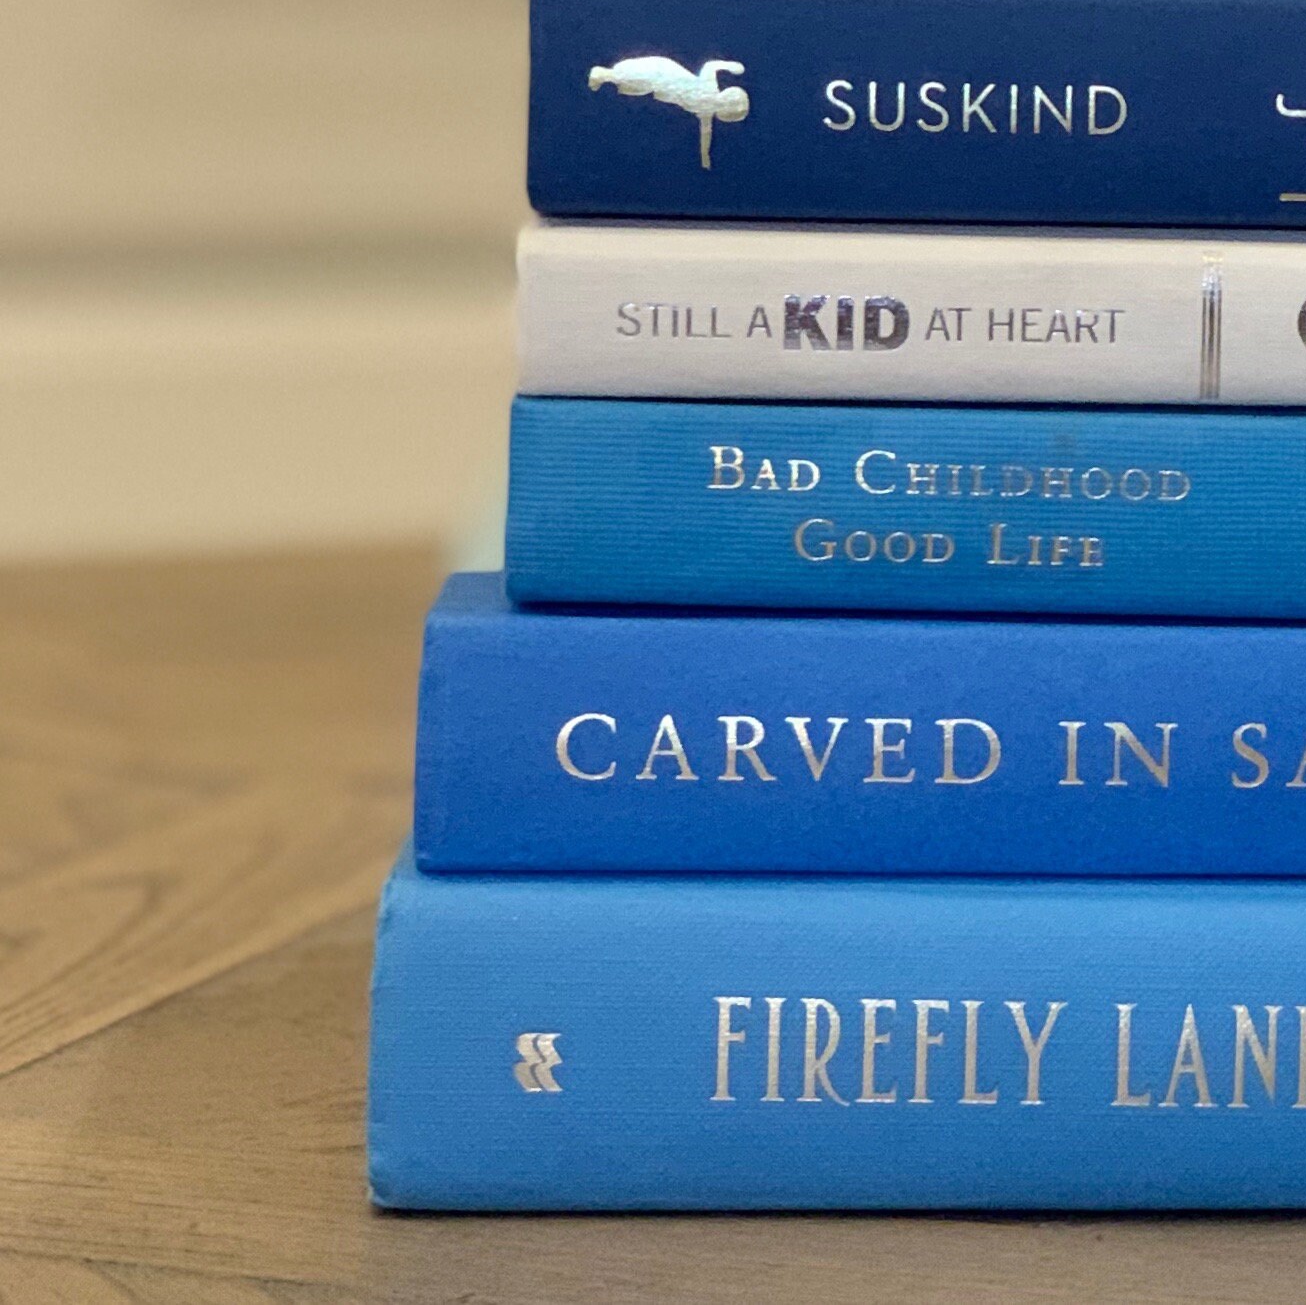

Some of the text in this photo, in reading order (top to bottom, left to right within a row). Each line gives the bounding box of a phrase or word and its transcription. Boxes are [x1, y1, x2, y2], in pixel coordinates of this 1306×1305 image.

[823, 78, 1130, 136] SUSKIND
[615, 294, 1127, 352] STILL A KID AT HEART
[707, 444, 1192, 502] BAD CHILDHOOD
[794, 517, 1105, 568] GOOD LIFE
[554, 712, 1002, 785] CARVED
[1058, 720, 1178, 789] IN
[709, 995, 1069, 1108] FIREFLY
